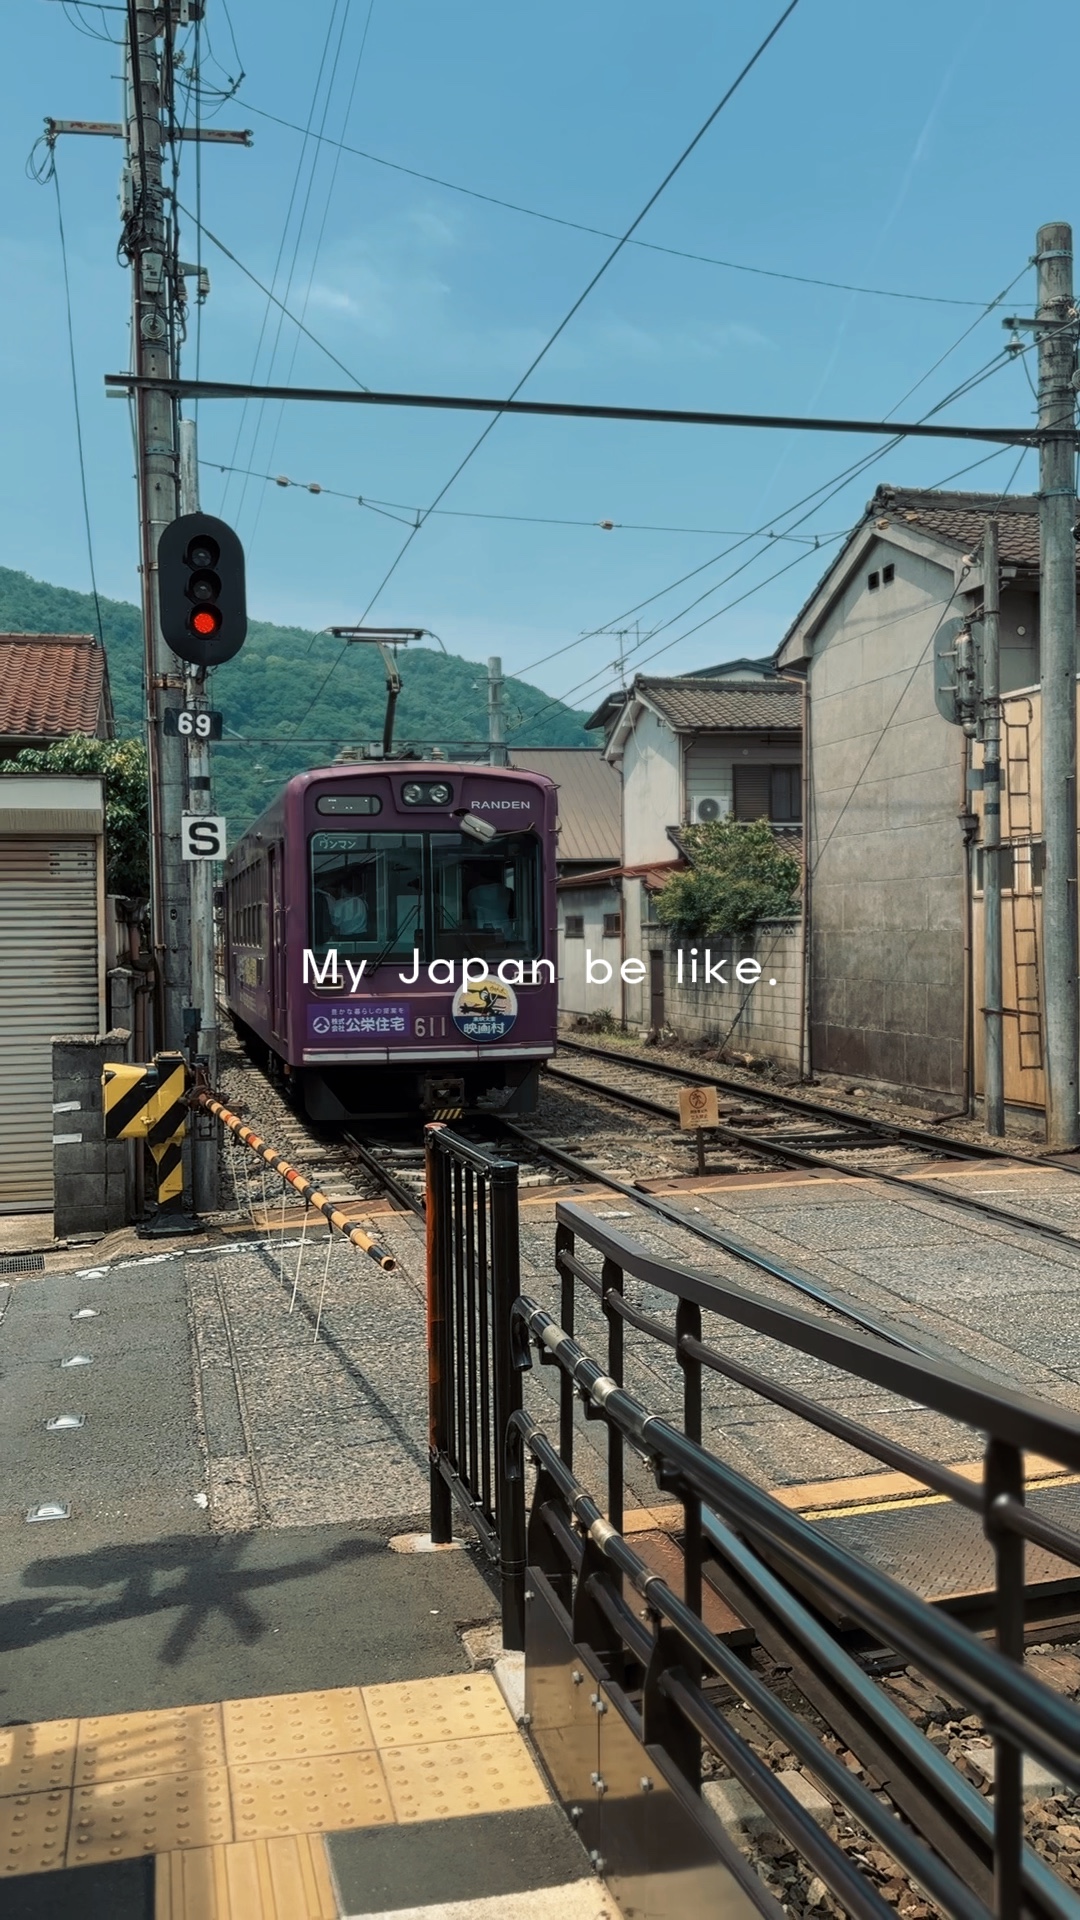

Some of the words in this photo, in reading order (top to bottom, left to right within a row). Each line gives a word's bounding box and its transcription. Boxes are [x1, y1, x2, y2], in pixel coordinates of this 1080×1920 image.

[177, 711, 211, 737] 69
[471, 801, 530, 809] RANDEN
[188, 821, 220, 856] S
[319, 840, 356, 849] ワンマン
[345, 1017, 405, 1032] 公栄住宅
[415, 1017, 446, 1037] 611
[463, 1022, 505, 1034] 映画村
